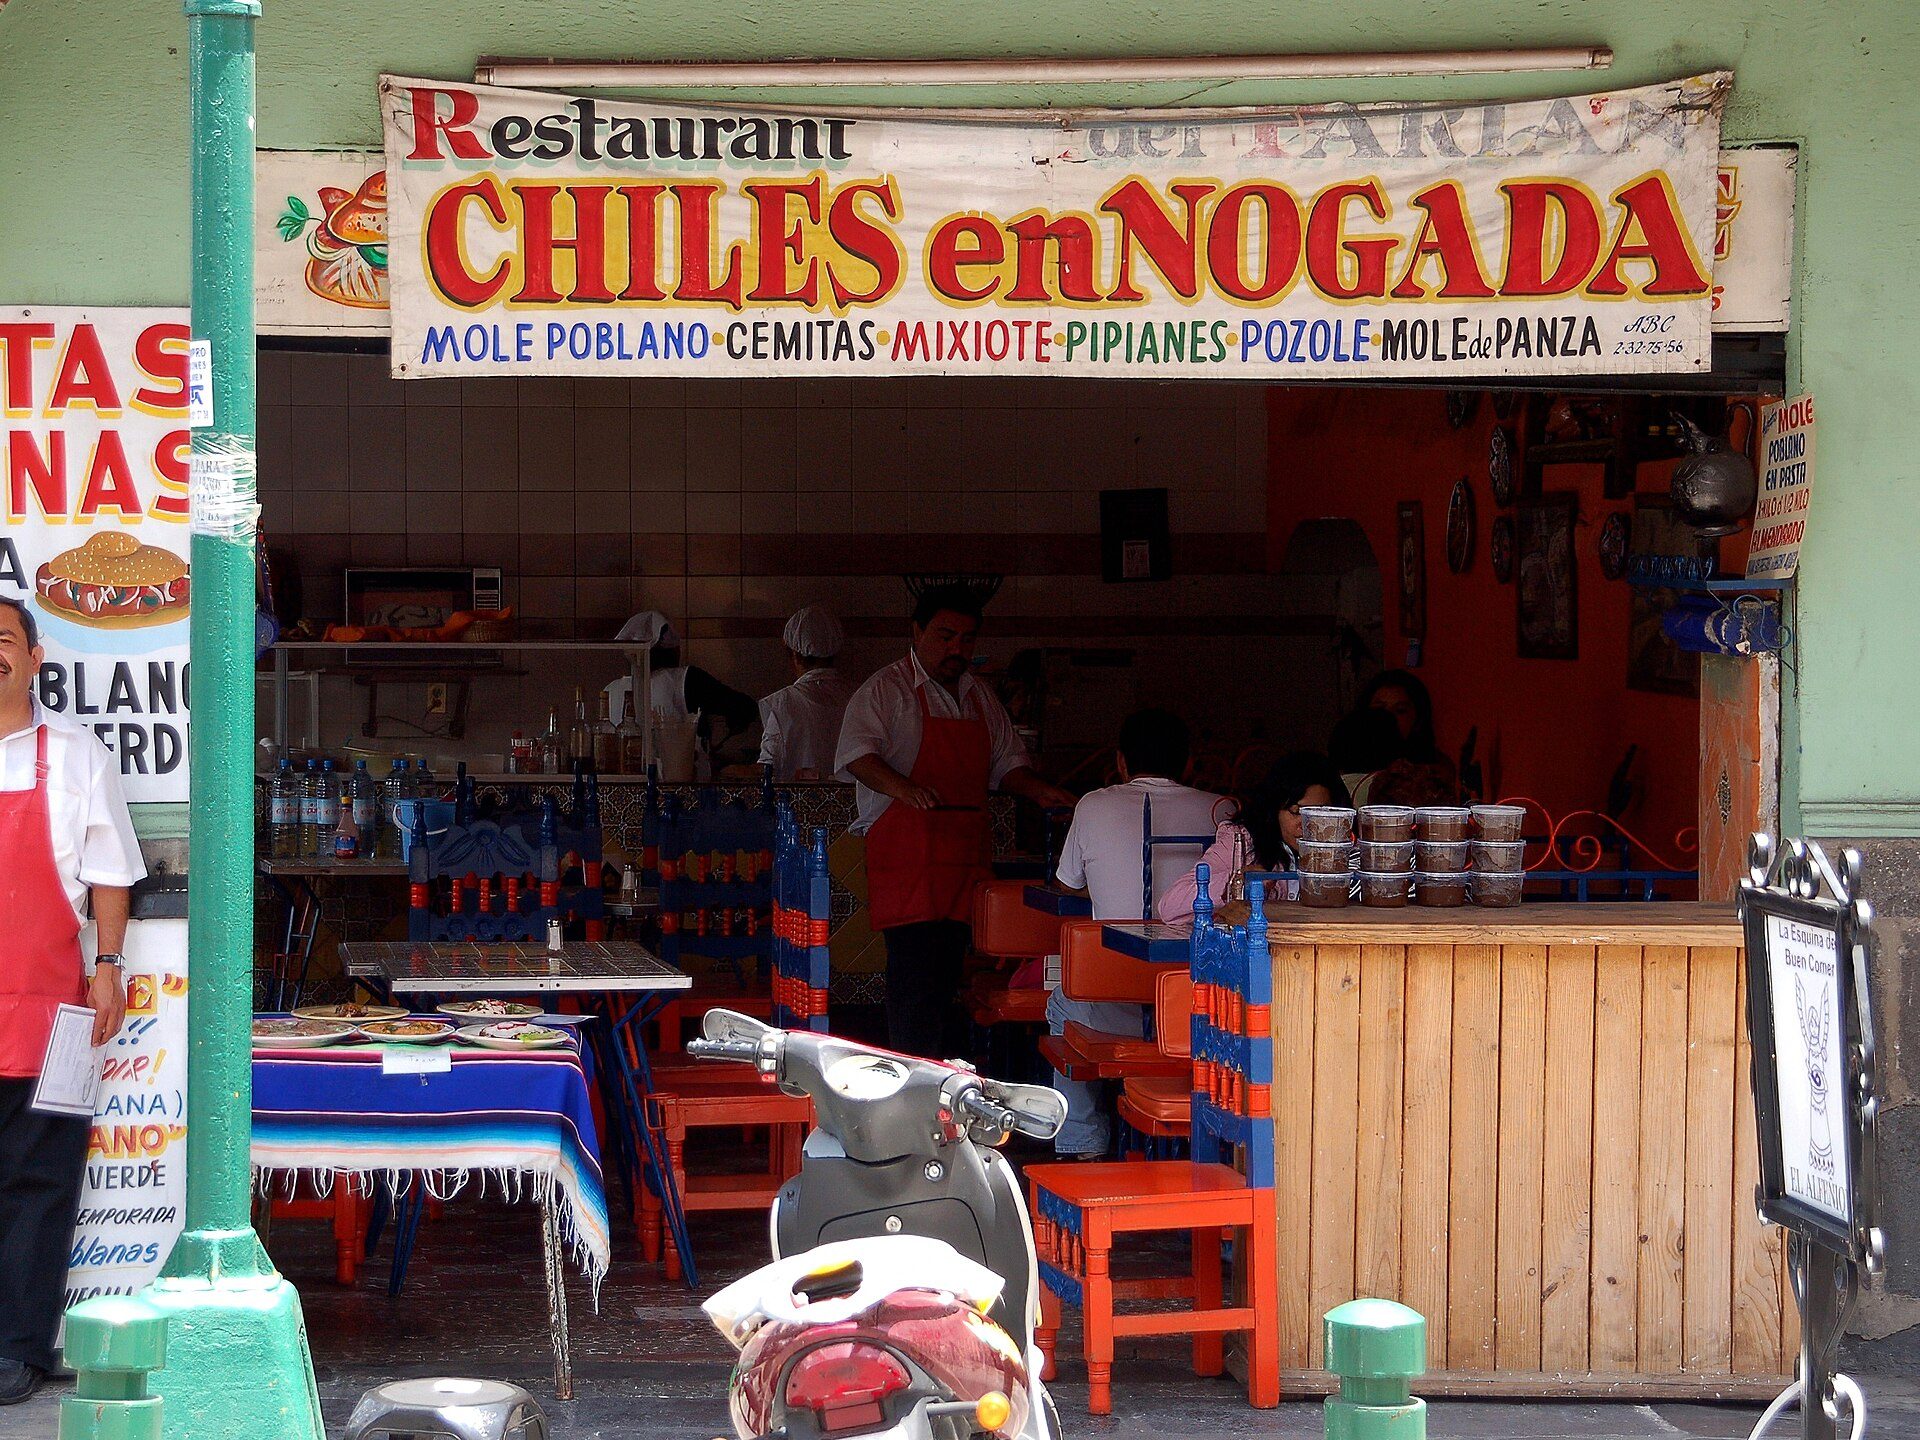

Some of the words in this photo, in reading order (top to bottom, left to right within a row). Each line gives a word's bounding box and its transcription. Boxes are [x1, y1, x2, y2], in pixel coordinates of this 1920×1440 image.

[405, 86, 857, 162] Restaurant
[425, 174, 903, 312] CHILES
[929, 214, 1103, 302] en
[1100, 179, 1710, 301] NOGADA
[422, 322, 534, 364] MOLE
[547, 322, 709, 361] POBLANO
[727, 320, 875, 361] CEMITAS
[891, 320, 1052, 362] MIXIOTE
[1066, 320, 1228, 363] PIPIANES
[1241, 319, 1370, 363] POZOLE
[1381, 317, 1469, 361] MOLE
[1469, 319, 1492, 359] de
[1495, 316, 1602, 358] PANZA
[1624, 314, 1676, 334] ABC
[0, 323, 190, 409] TAS
[1778, 399, 1813, 433] MOLE
[1768, 433, 1806, 466] POBLANO
[9, 430, 190, 515] NAS
[1765, 469, 1778, 491] EN
[1779, 462, 1806, 488] PASTA
[1778, 920, 1789, 939] La
[1791, 923, 1824, 948] Esquina
[1785, 948, 1807, 971] Buen
[1809, 954, 1835, 977] Comer
[88, 1164, 166, 1190] VERDE
